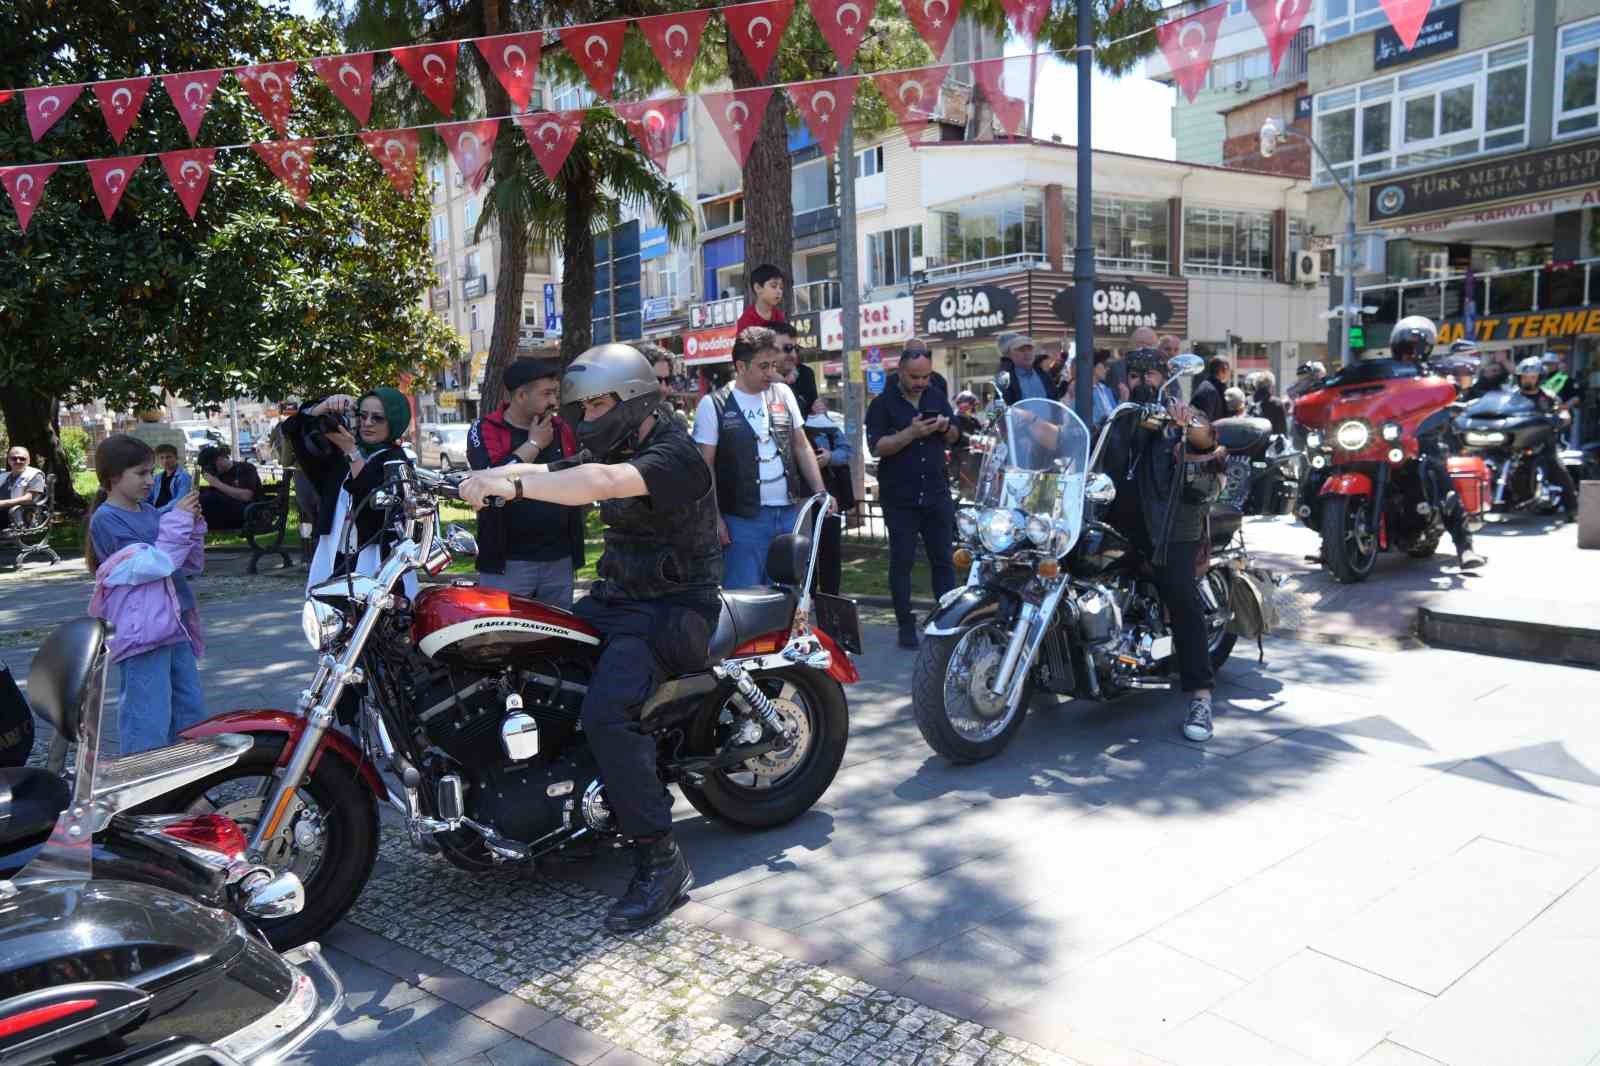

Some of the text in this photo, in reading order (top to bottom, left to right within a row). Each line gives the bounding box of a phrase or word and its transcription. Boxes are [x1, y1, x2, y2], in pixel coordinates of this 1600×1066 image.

[1468, 161, 1536, 188] METAL
[927, 309, 1005, 334] Restaurant
[1506, 308, 1600, 340] TERME
[473, 620, 571, 636] HARLEY-DAVIDSON
